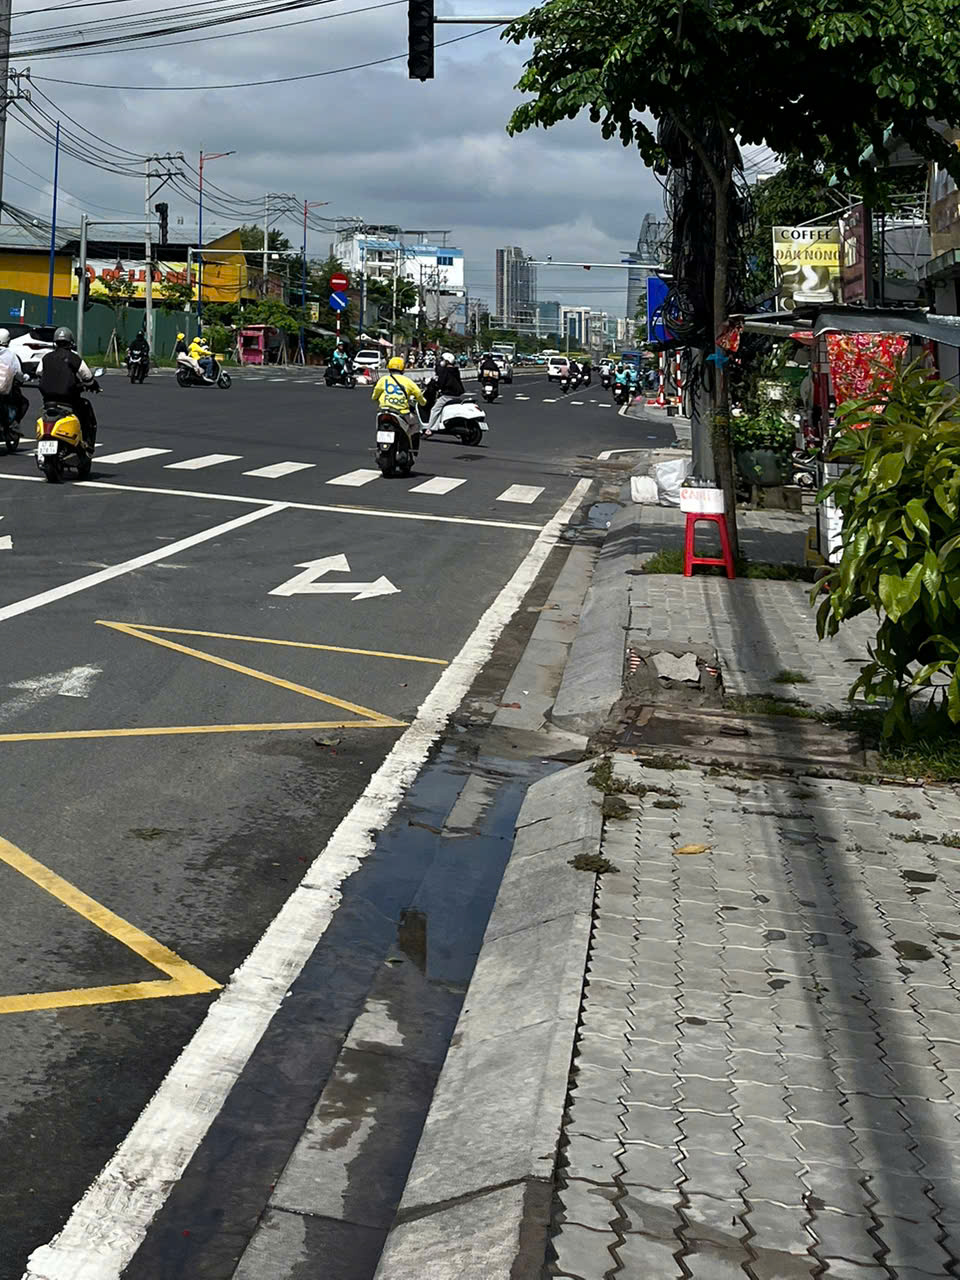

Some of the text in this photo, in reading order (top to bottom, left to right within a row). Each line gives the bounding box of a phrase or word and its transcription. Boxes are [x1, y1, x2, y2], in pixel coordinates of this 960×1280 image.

[781, 229, 831, 240] COFFEE
[385, 379, 404, 395] be
[384, 394, 406, 405] Food
